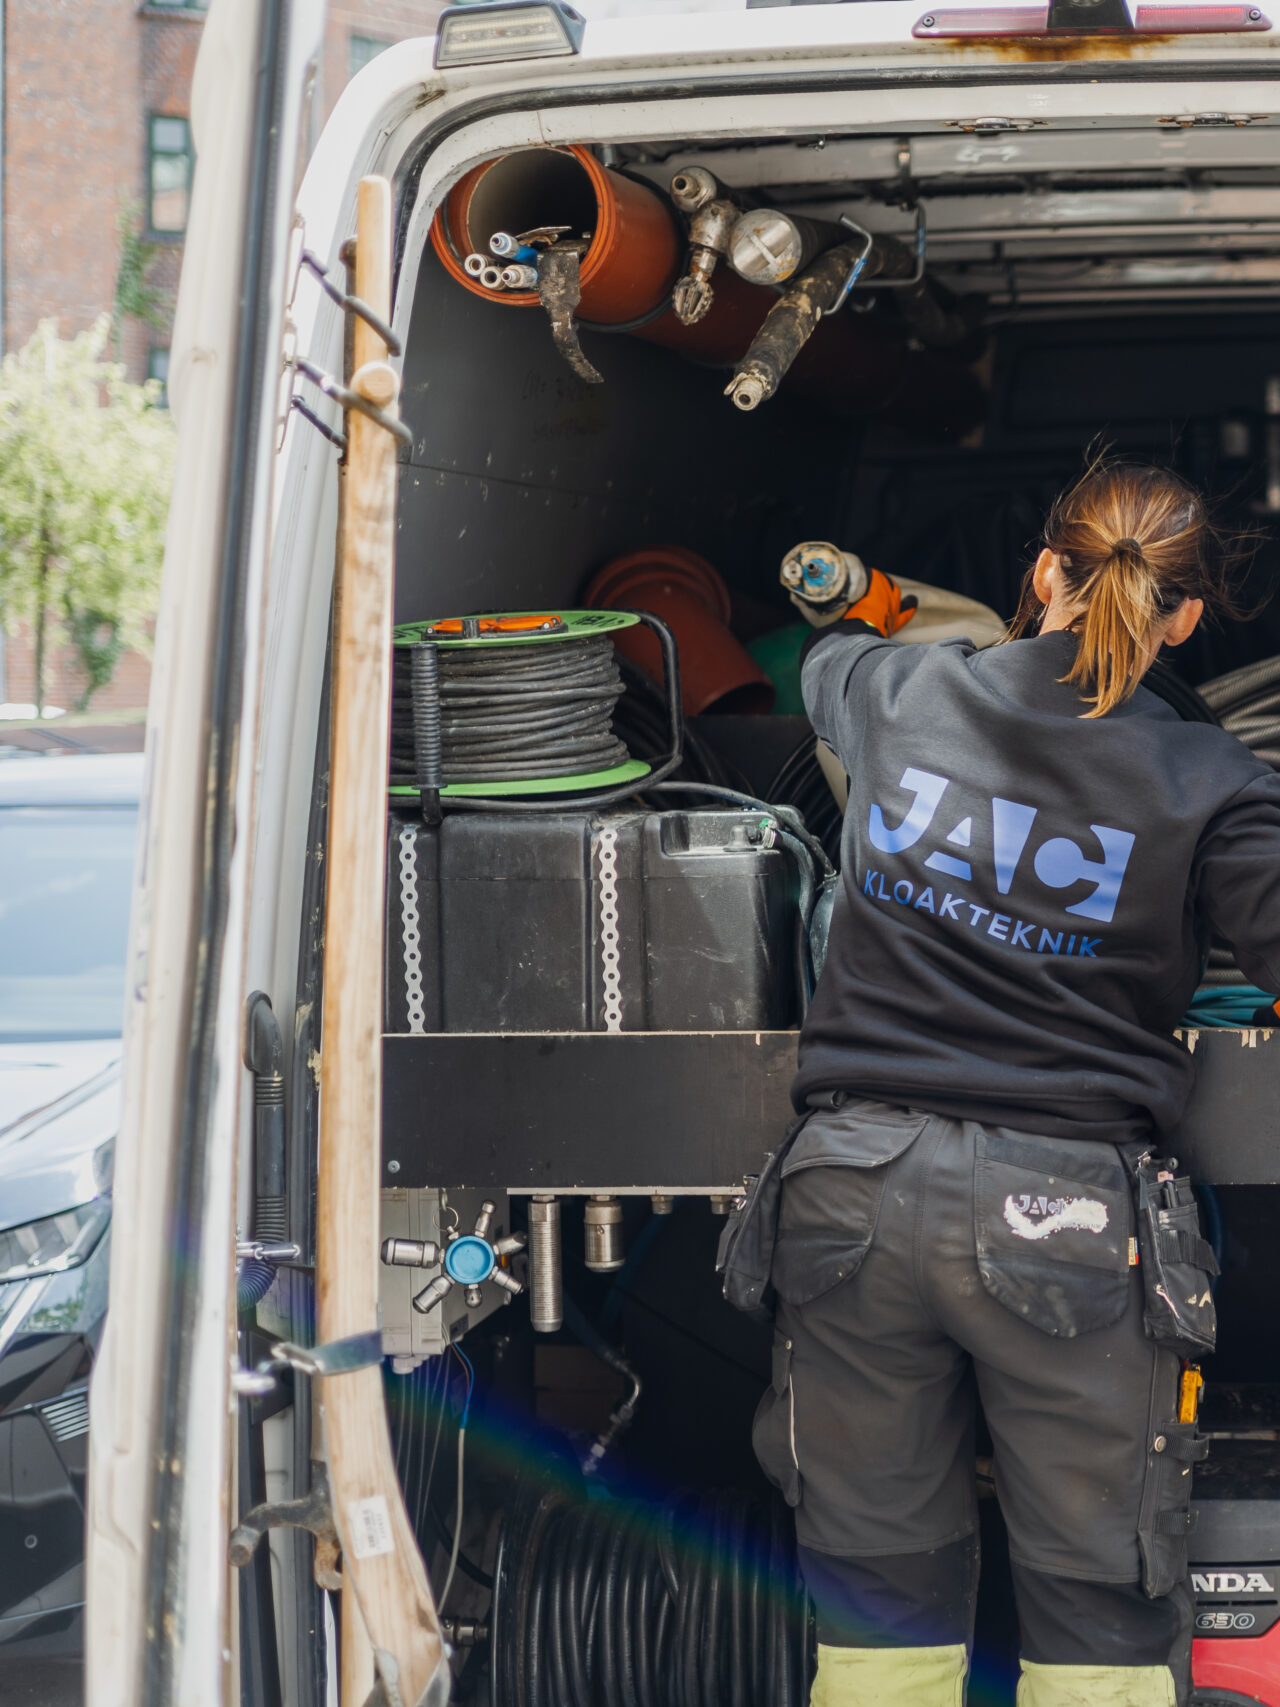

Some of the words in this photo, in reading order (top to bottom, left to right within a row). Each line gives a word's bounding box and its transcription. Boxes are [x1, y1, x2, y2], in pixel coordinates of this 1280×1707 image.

[868, 767, 1136, 923] JAC
[864, 869, 1102, 958] KLOAKTEKNIK
[1196, 1613, 1255, 1629] 630
